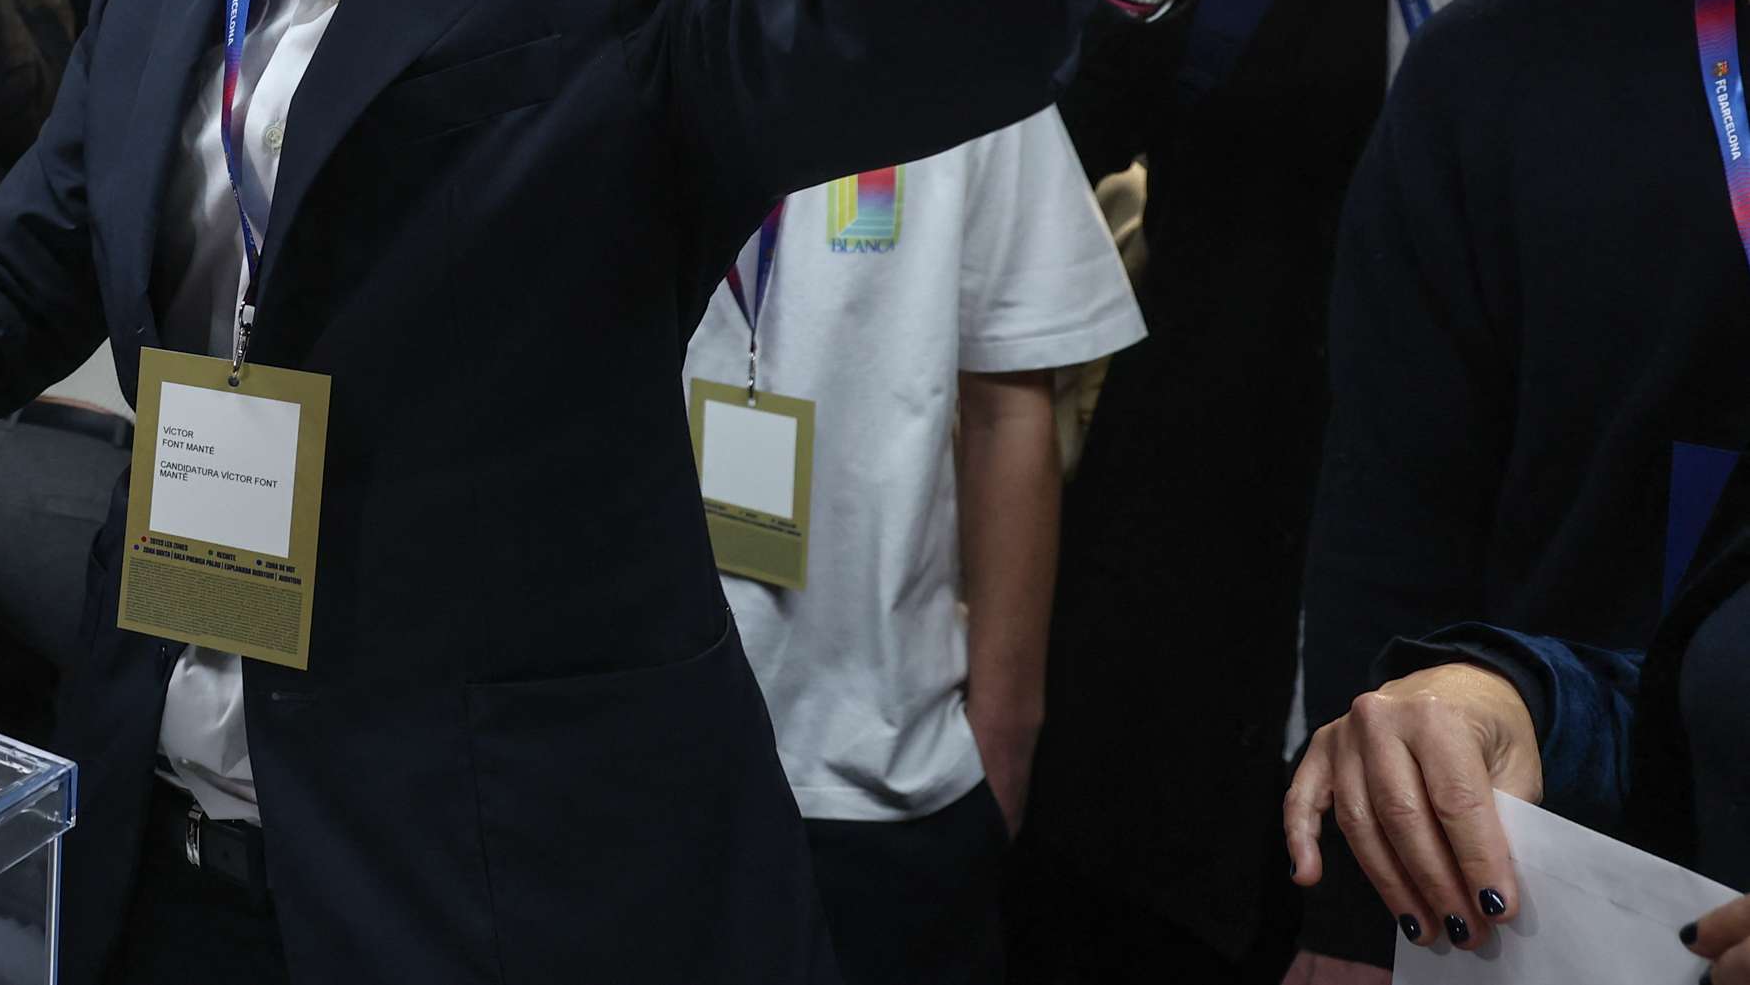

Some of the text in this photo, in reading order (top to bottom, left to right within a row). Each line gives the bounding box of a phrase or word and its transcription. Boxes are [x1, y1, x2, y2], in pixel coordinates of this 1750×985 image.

[1715, 78, 1742, 161] FC BARCELONA
[162, 425, 194, 439] VÍCTOR
[162, 438, 215, 455] FONT MANTÉ
[159, 469, 189, 482] MANTÉ
[160, 460, 278, 488] CANDIDATURA VÍCTOR FONT
